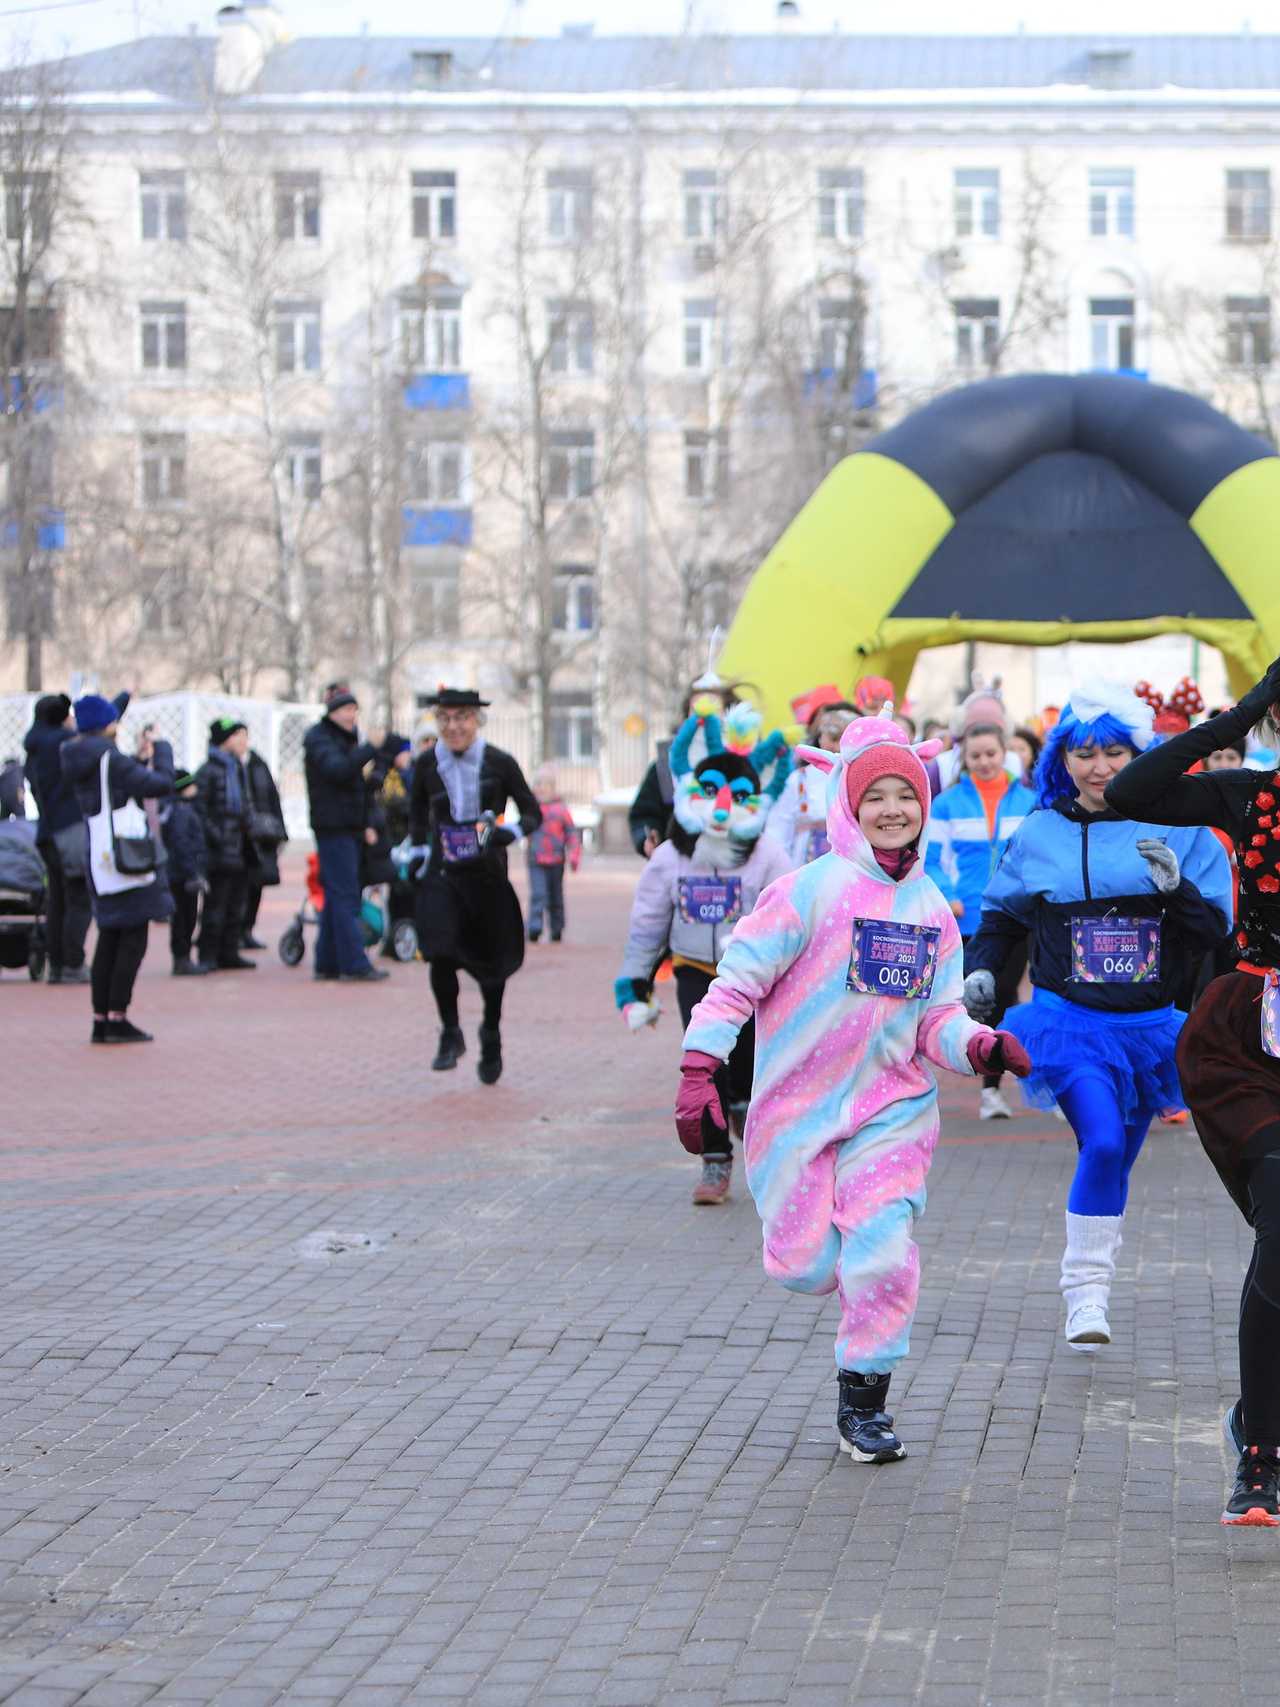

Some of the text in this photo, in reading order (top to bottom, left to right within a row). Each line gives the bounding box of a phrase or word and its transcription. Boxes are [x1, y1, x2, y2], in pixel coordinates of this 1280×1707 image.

[700, 904, 725, 919] 028
[872, 935, 919, 945] КОСТЮМИРОВАННЫЙ
[1093, 935, 1139, 944] ЖЕНСКИЙ
[871, 941, 918, 955] ЖЕНСКИЙ
[1093, 943, 1139, 952] ЗАБЕГ 2023
[870, 950, 916, 964] ЗАБЕГ 2023
[1103, 957, 1134, 974] 066
[879, 966, 910, 987] 003
